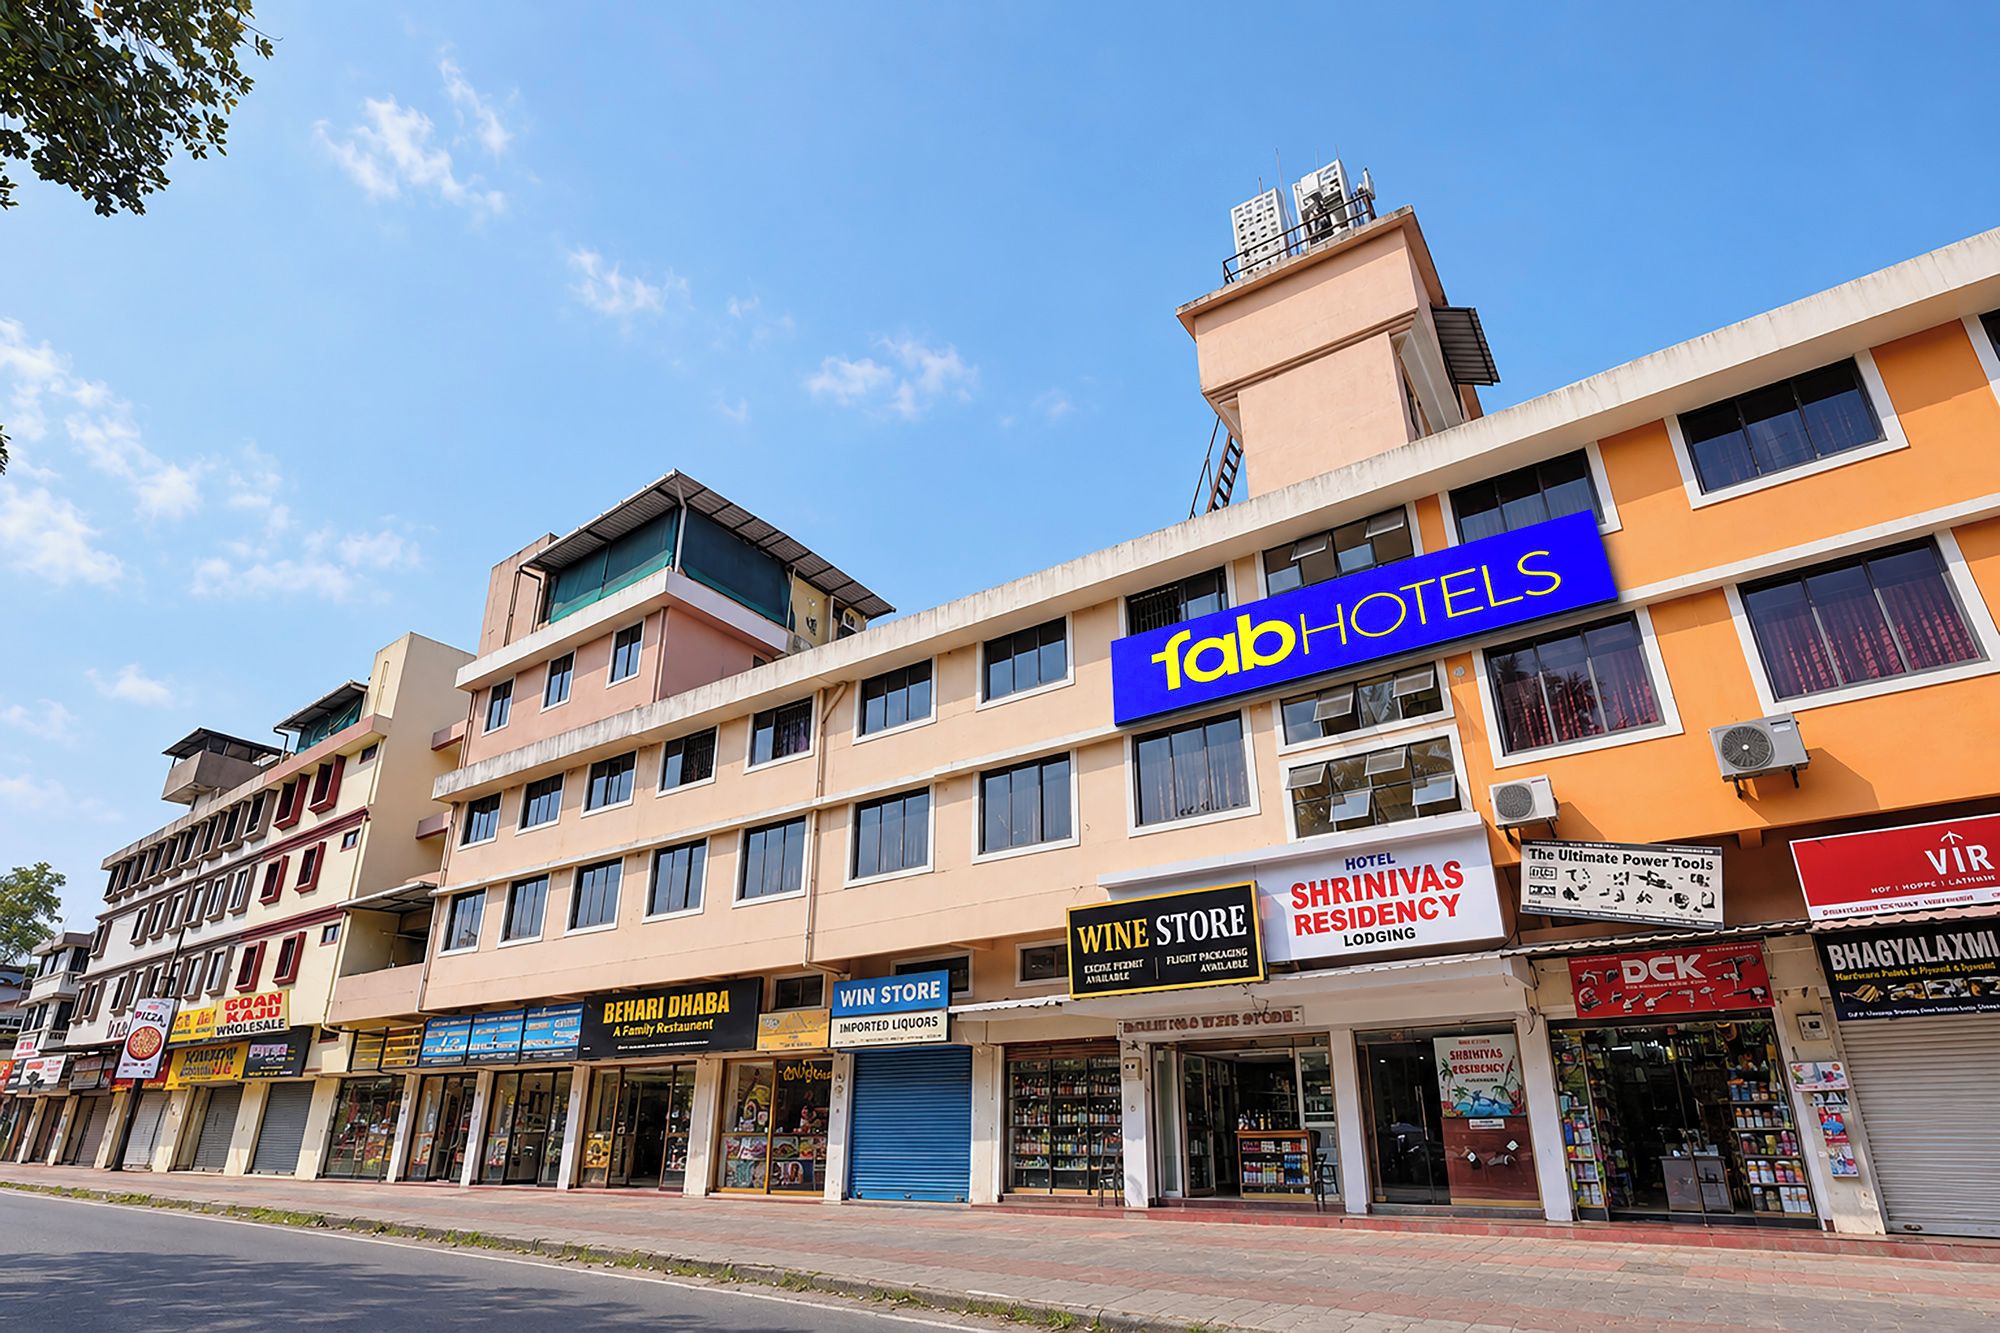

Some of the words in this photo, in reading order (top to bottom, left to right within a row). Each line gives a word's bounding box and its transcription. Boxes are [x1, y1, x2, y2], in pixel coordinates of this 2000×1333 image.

[1344, 852, 1396, 871] HOTEL
[1529, 848, 1555, 861] The
[1558, 849, 1619, 865] Ultimate
[1622, 853, 1669, 868] Power
[1671, 856, 1714, 871] Tools
[1925, 844, 1995, 876] VIR
[1290, 860, 1464, 910] SHRINIVAS
[1294, 893, 1461, 936] RESIDENCY
[1077, 918, 1149, 954] WINE
[1156, 904, 1248, 946] STORE
[1343, 927, 1416, 947] LODGING
[1199, 947, 1248, 962] PACKAGING
[1200, 958, 1249, 973] AVAILABLE
[1620, 954, 1706, 984] DCK
[224, 992, 283, 1011] GOAN
[840, 987, 876, 1008] WIN
[880, 980, 941, 1004] STORE
[226, 1005, 281, 1024] KAJU
[603, 996, 665, 1024] BEHARI
[667, 990, 730, 1018] DHABA
[216, 1018, 286, 1036] WHOLESALE
[612, 1025, 621, 1038] A
[622, 1022, 655, 1038] Family
[840, 1020, 889, 1034] IMPORTED
[892, 1016, 938, 1032] LIQUORS
